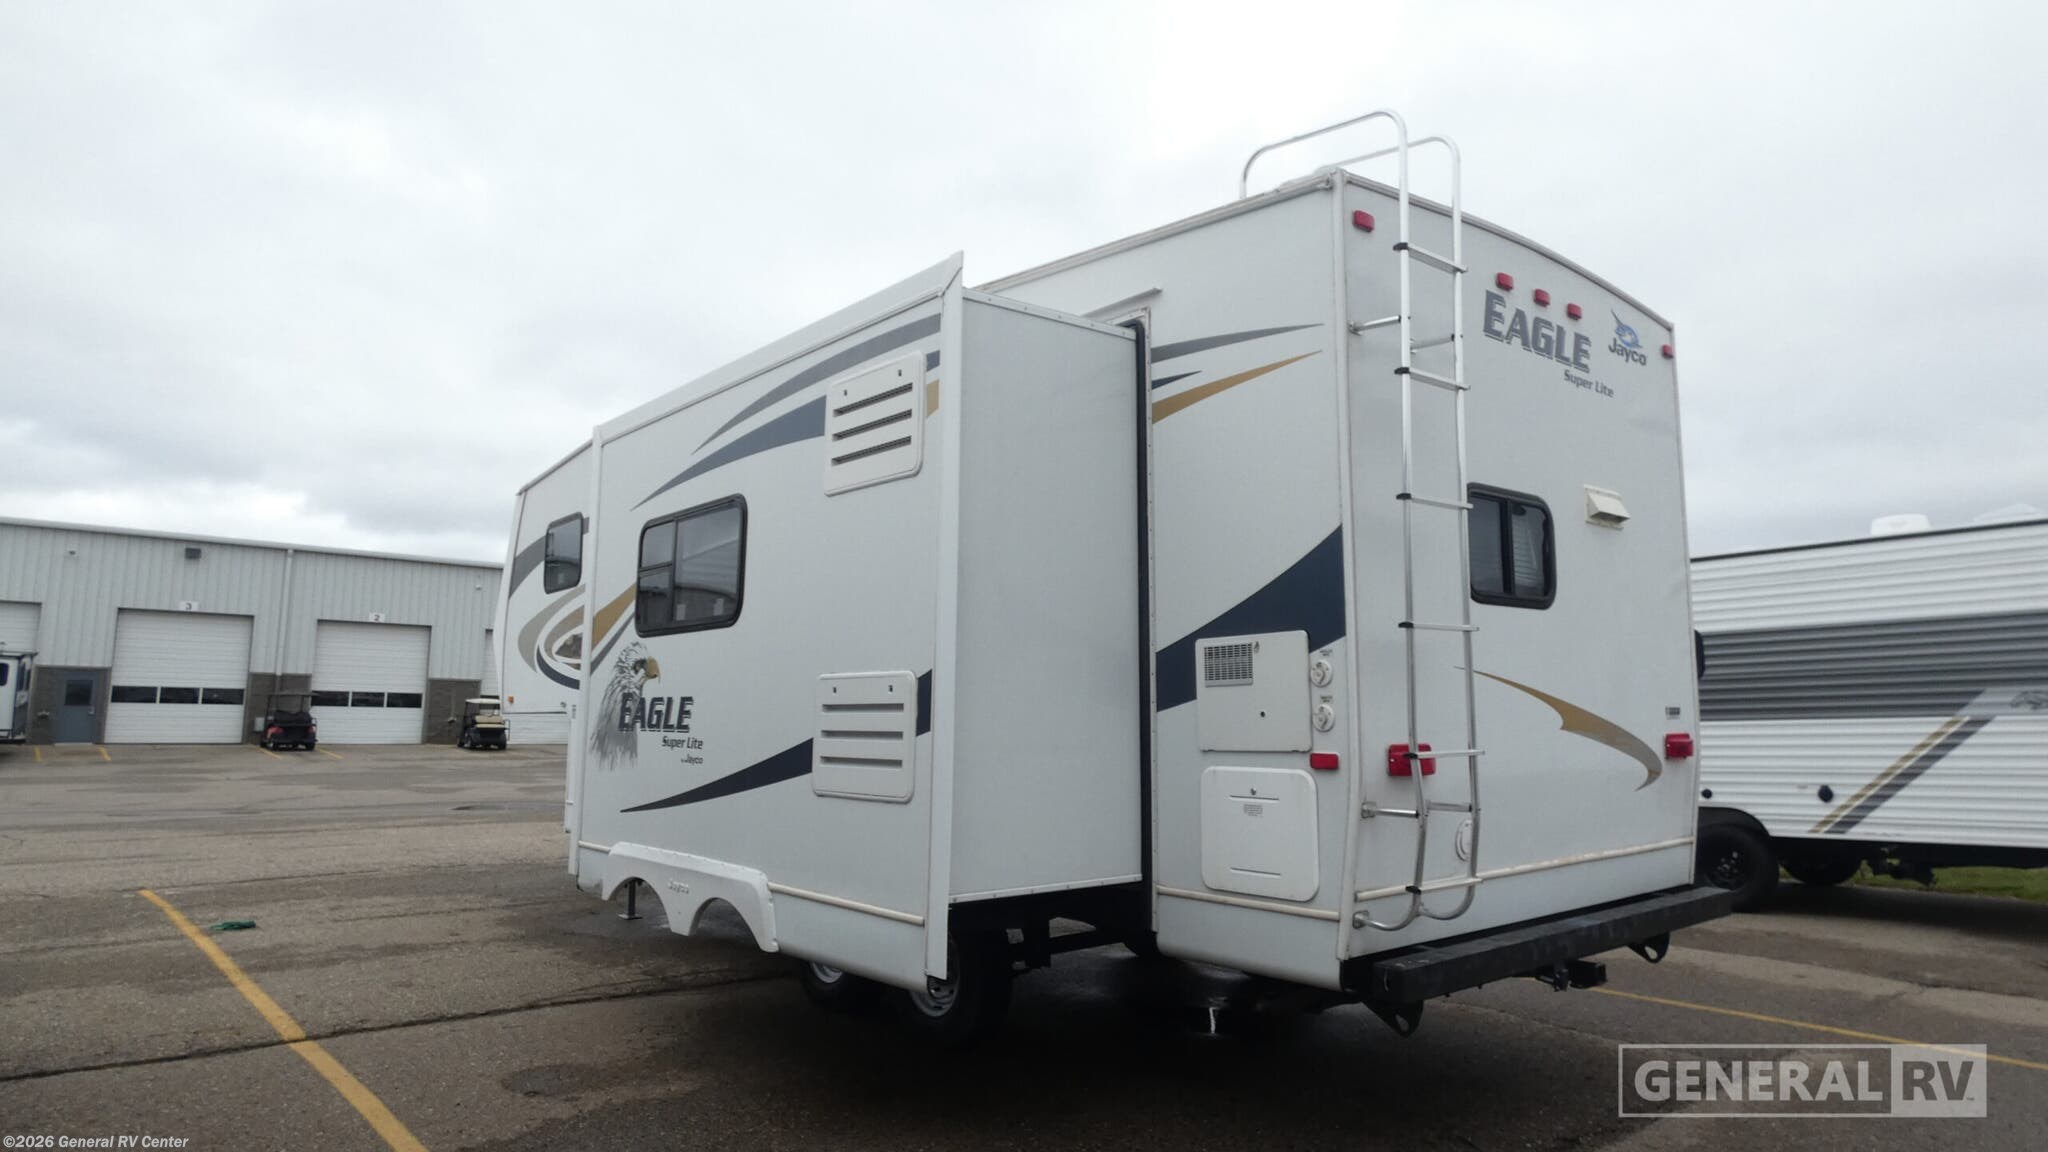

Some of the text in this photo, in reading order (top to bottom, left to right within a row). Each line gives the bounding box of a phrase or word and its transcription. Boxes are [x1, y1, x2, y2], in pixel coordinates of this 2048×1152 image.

[1483, 289, 1592, 373] EAGLE
[1608, 337, 1648, 367] Jayco
[1563, 369, 1615, 398] Super Lite
[618, 691, 694, 734] EAGLE
[661, 735, 704, 750] Super Lite
